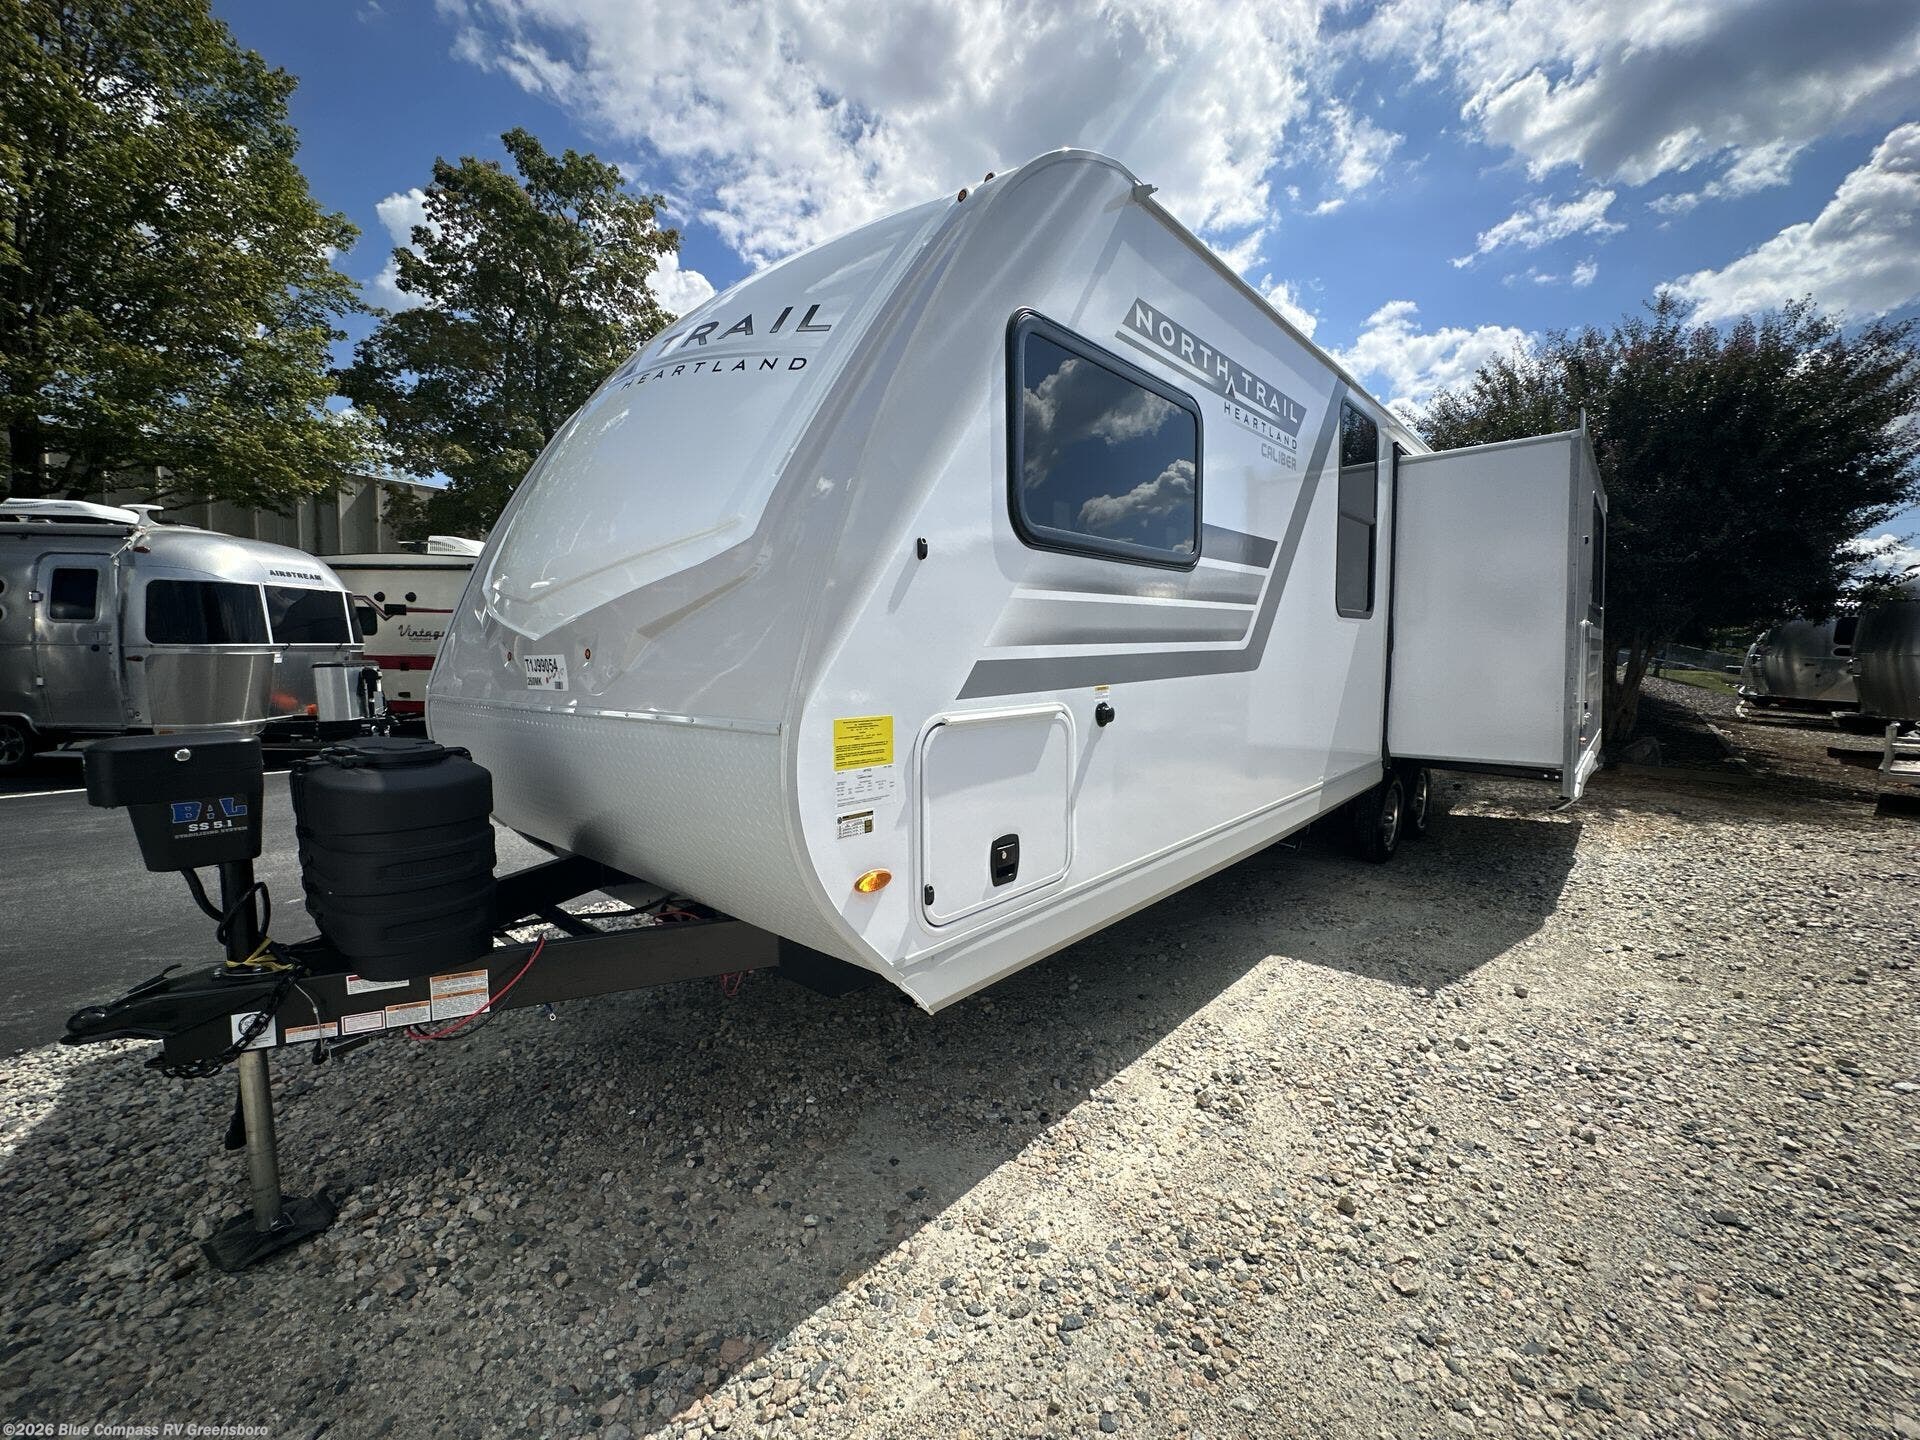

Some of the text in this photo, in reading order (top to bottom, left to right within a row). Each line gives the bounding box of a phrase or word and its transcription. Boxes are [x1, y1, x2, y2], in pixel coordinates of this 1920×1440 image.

[656, 304, 832, 357] TRAIL
[621, 357, 808, 391] HEARTLAND
[1135, 303, 1298, 424] NORTH TRAIL
[1224, 402, 1298, 450] HEARTLAND
[1261, 443, 1297, 471] CALIBER
[270, 569, 322, 580] AIRSTREAM
[188, 822, 210, 832] SS
